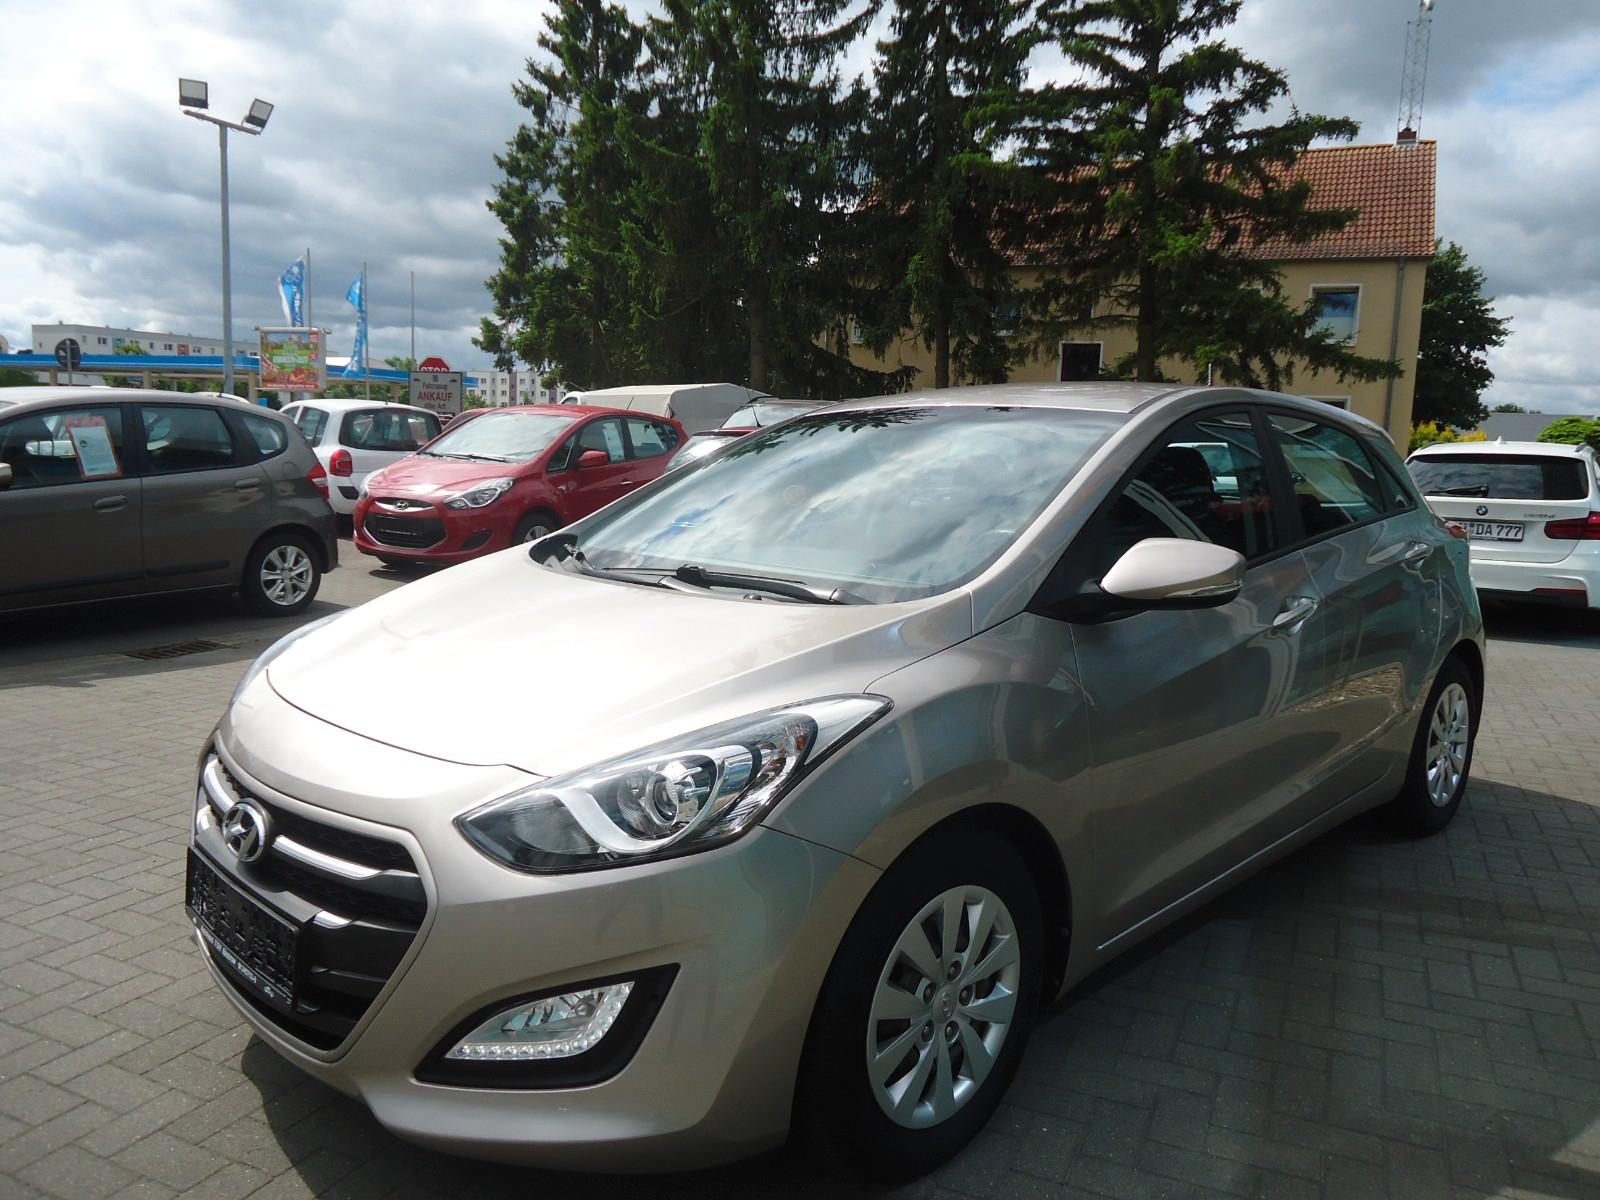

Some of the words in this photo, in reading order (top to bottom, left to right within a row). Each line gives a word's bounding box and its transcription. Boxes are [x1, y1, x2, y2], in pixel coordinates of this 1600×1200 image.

[417, 392, 453, 401] ANKAUF
[1475, 523, 1493, 536] DA
[1496, 525, 1522, 538] 777
